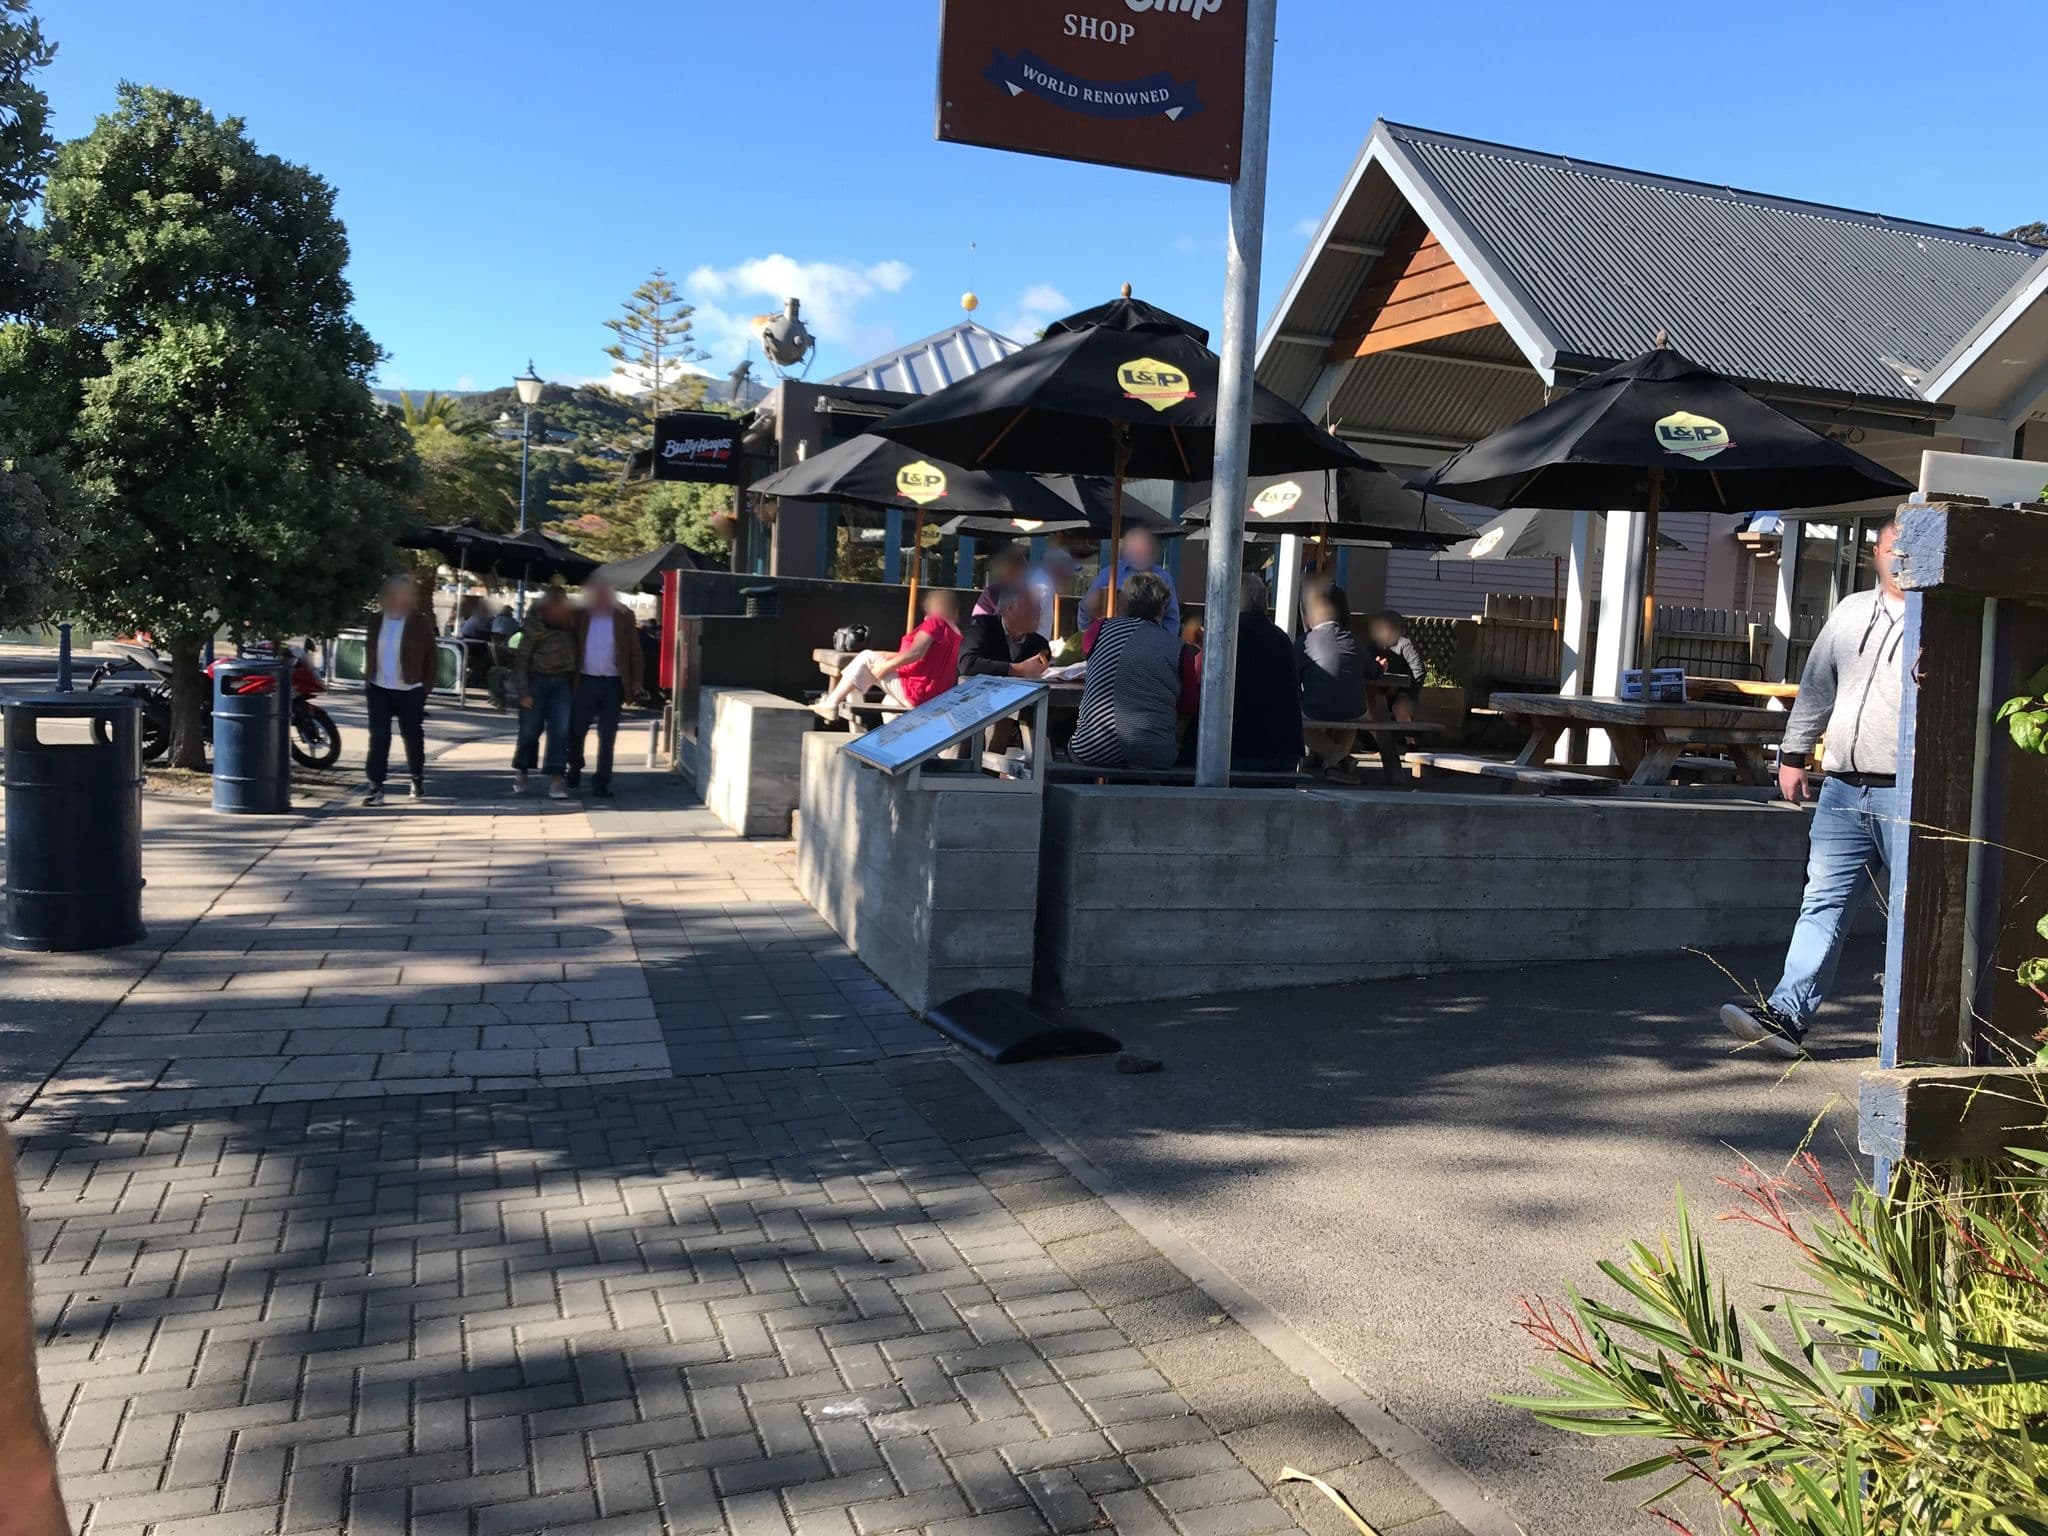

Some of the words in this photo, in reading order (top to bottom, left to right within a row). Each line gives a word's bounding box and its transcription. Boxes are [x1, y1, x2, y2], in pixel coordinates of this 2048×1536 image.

[1063, 13, 1135, 46] SHOP
[1022, 64, 1079, 98] WORLD
[1083, 88, 1170, 105] RENOWNED
[1122, 369, 1184, 387] L&P
[1658, 425, 1722, 441] L&P
[900, 472, 942, 488] L&P
